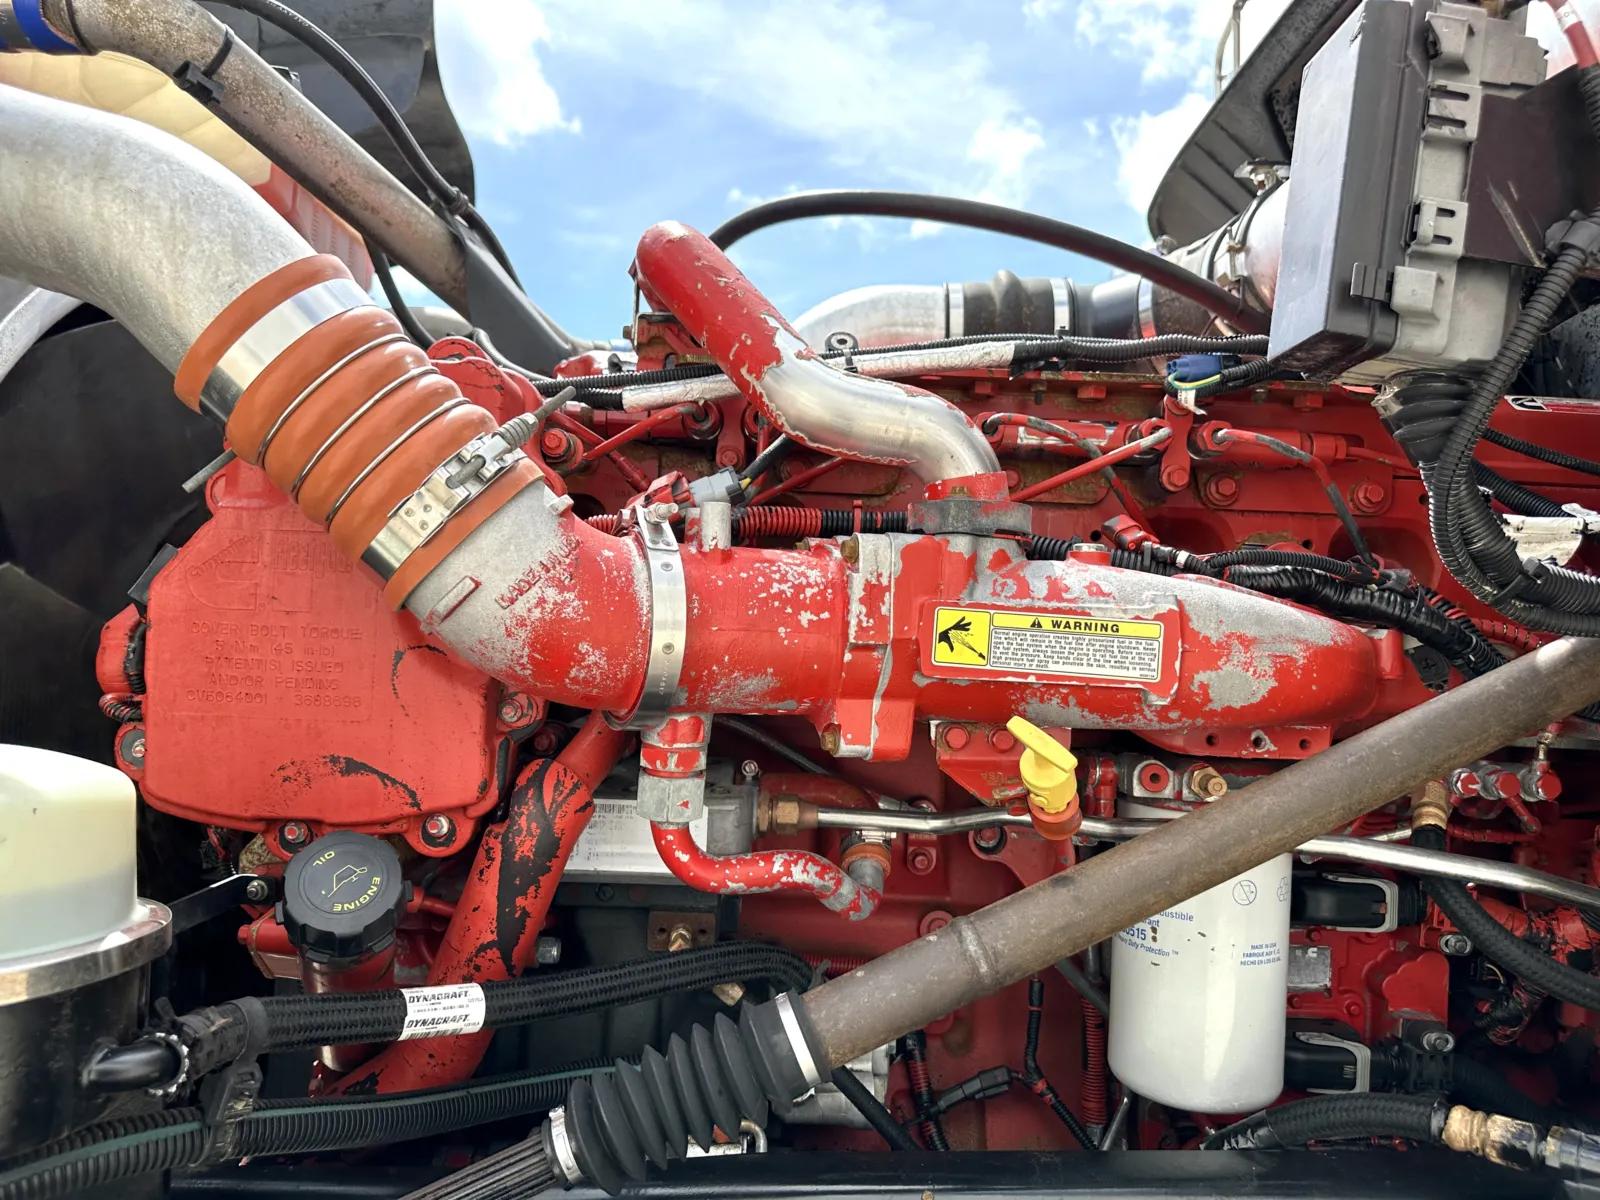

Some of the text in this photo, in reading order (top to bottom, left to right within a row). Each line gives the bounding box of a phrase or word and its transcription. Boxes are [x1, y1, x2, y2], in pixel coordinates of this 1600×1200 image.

[495, 566, 541, 609] MADE
[191, 622, 362, 640] COVER BOLT TORQUE
[1051, 620, 1120, 633] WARNING
[291, 660, 344, 673] ISSUED
[209, 673, 341, 690] AND/OR PENDING
[312, 850, 335, 866] OIL
[332, 877, 381, 911] ENGINE
[1140, 943, 1170, 957] Protection
[408, 990, 468, 1004] DYNACRAFT
[406, 1014, 470, 1029] DYNACRAFT
